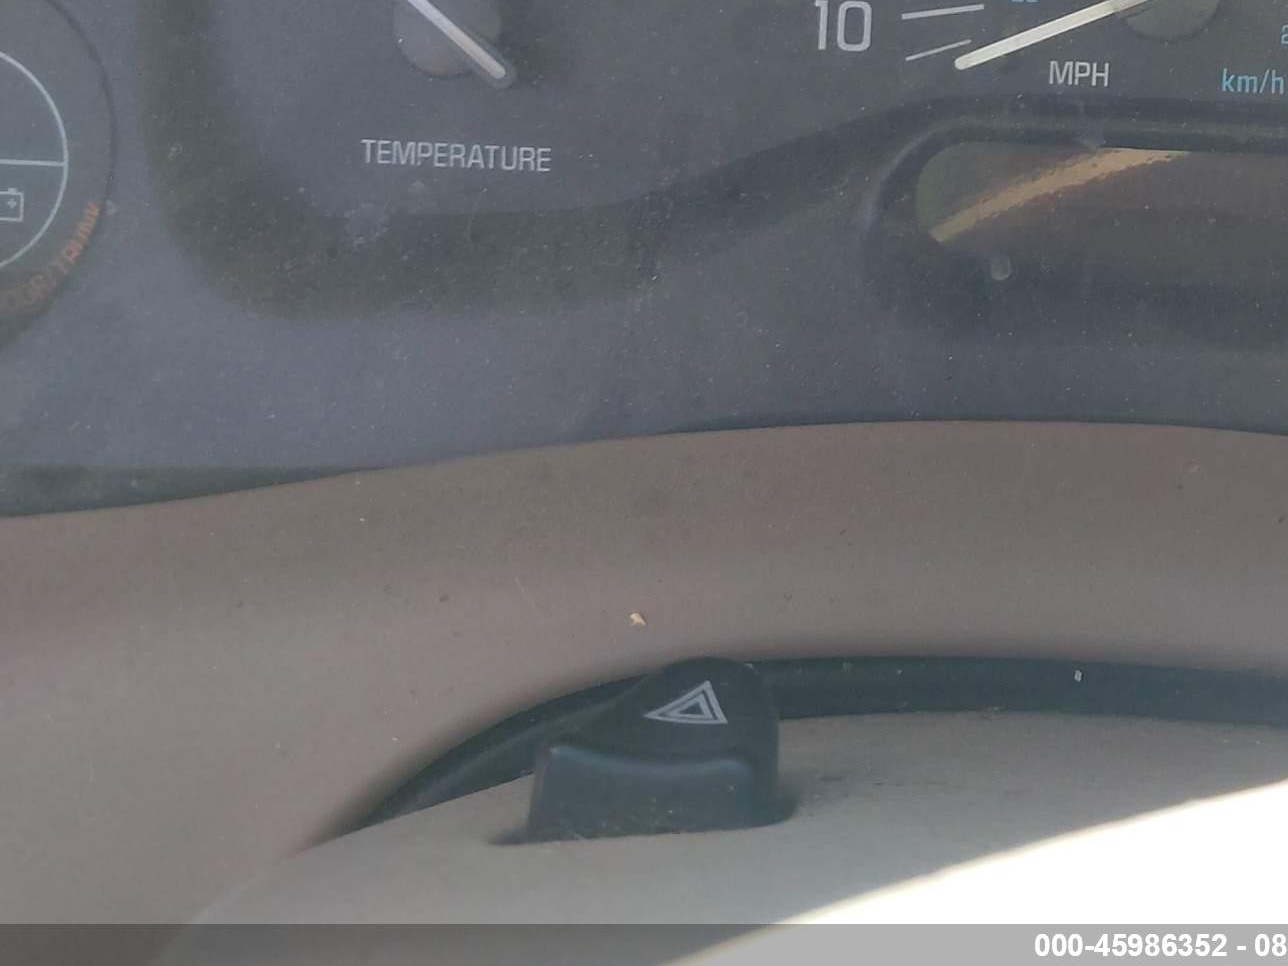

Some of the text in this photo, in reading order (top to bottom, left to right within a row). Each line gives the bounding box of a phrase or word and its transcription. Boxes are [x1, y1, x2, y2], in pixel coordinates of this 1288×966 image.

[814, 0, 871, 52] 10
[1050, 61, 1109, 86] MPH
[1222, 69, 1284, 95] km/h
[361, 139, 551, 172] TEMPERATURE
